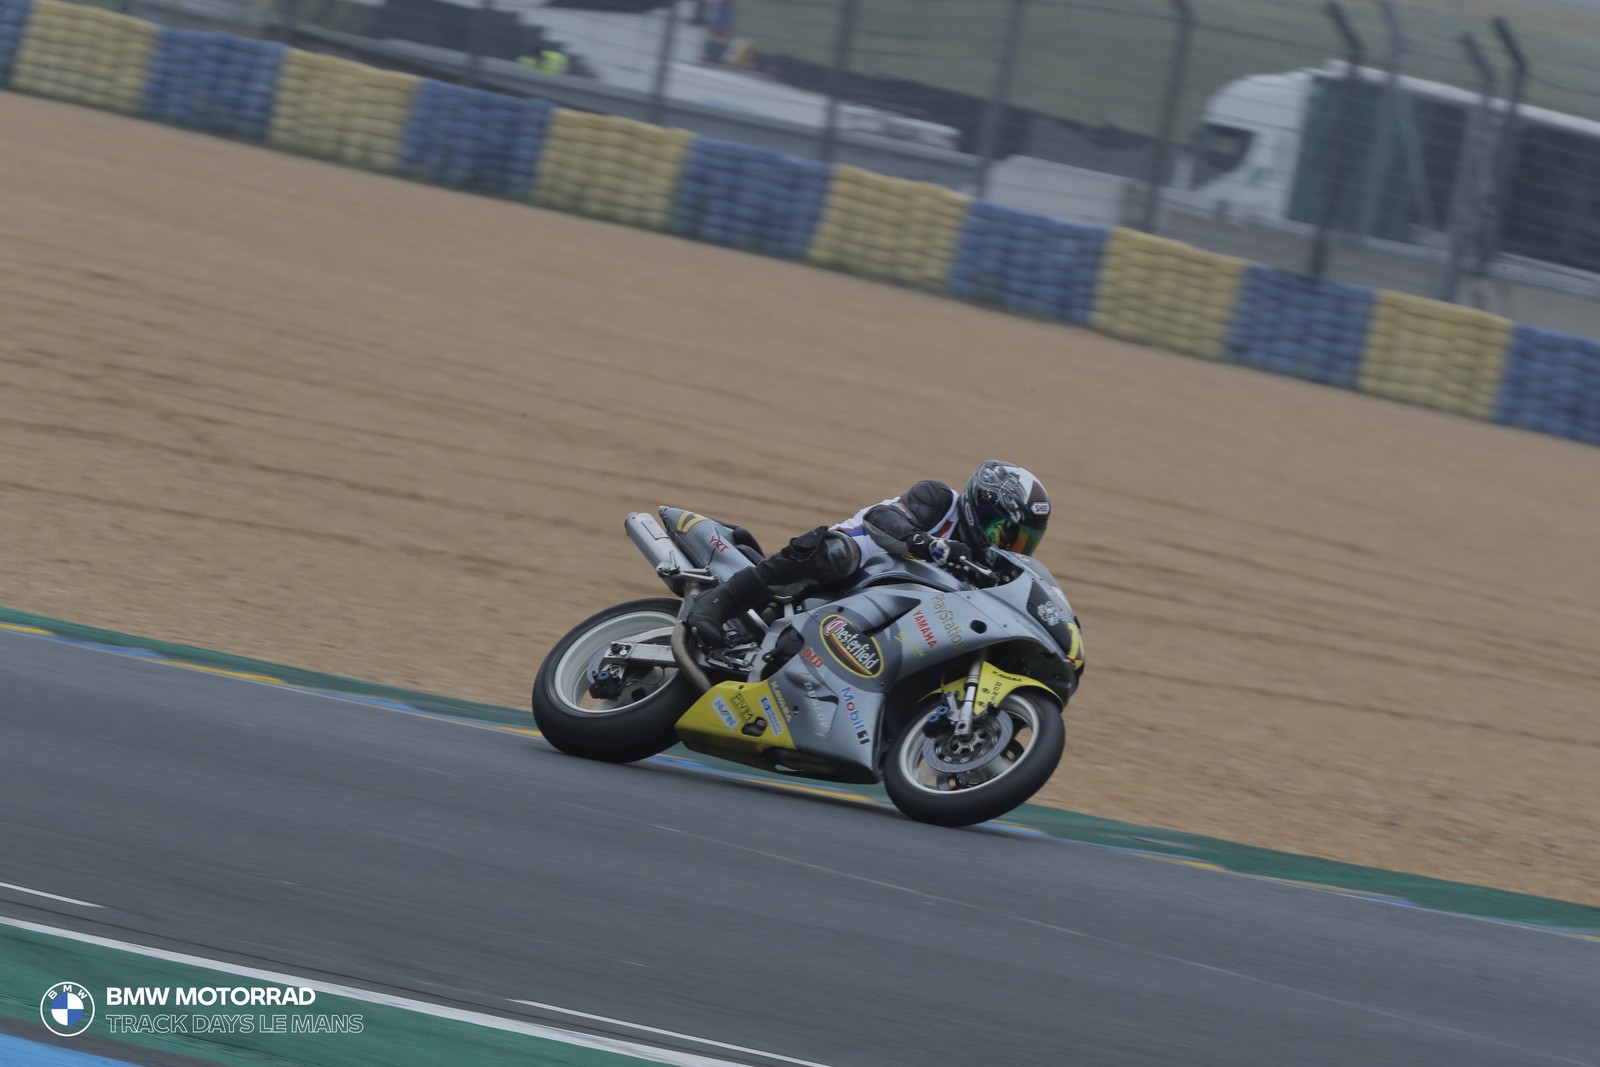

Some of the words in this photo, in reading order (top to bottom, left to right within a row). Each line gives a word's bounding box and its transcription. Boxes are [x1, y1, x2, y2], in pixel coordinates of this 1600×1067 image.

[824, 615, 880, 670] Chesterfield
[912, 609, 938, 648] YAMAHA
[932, 593, 967, 649] PlayStation
[841, 686, 864, 734] Mobil
